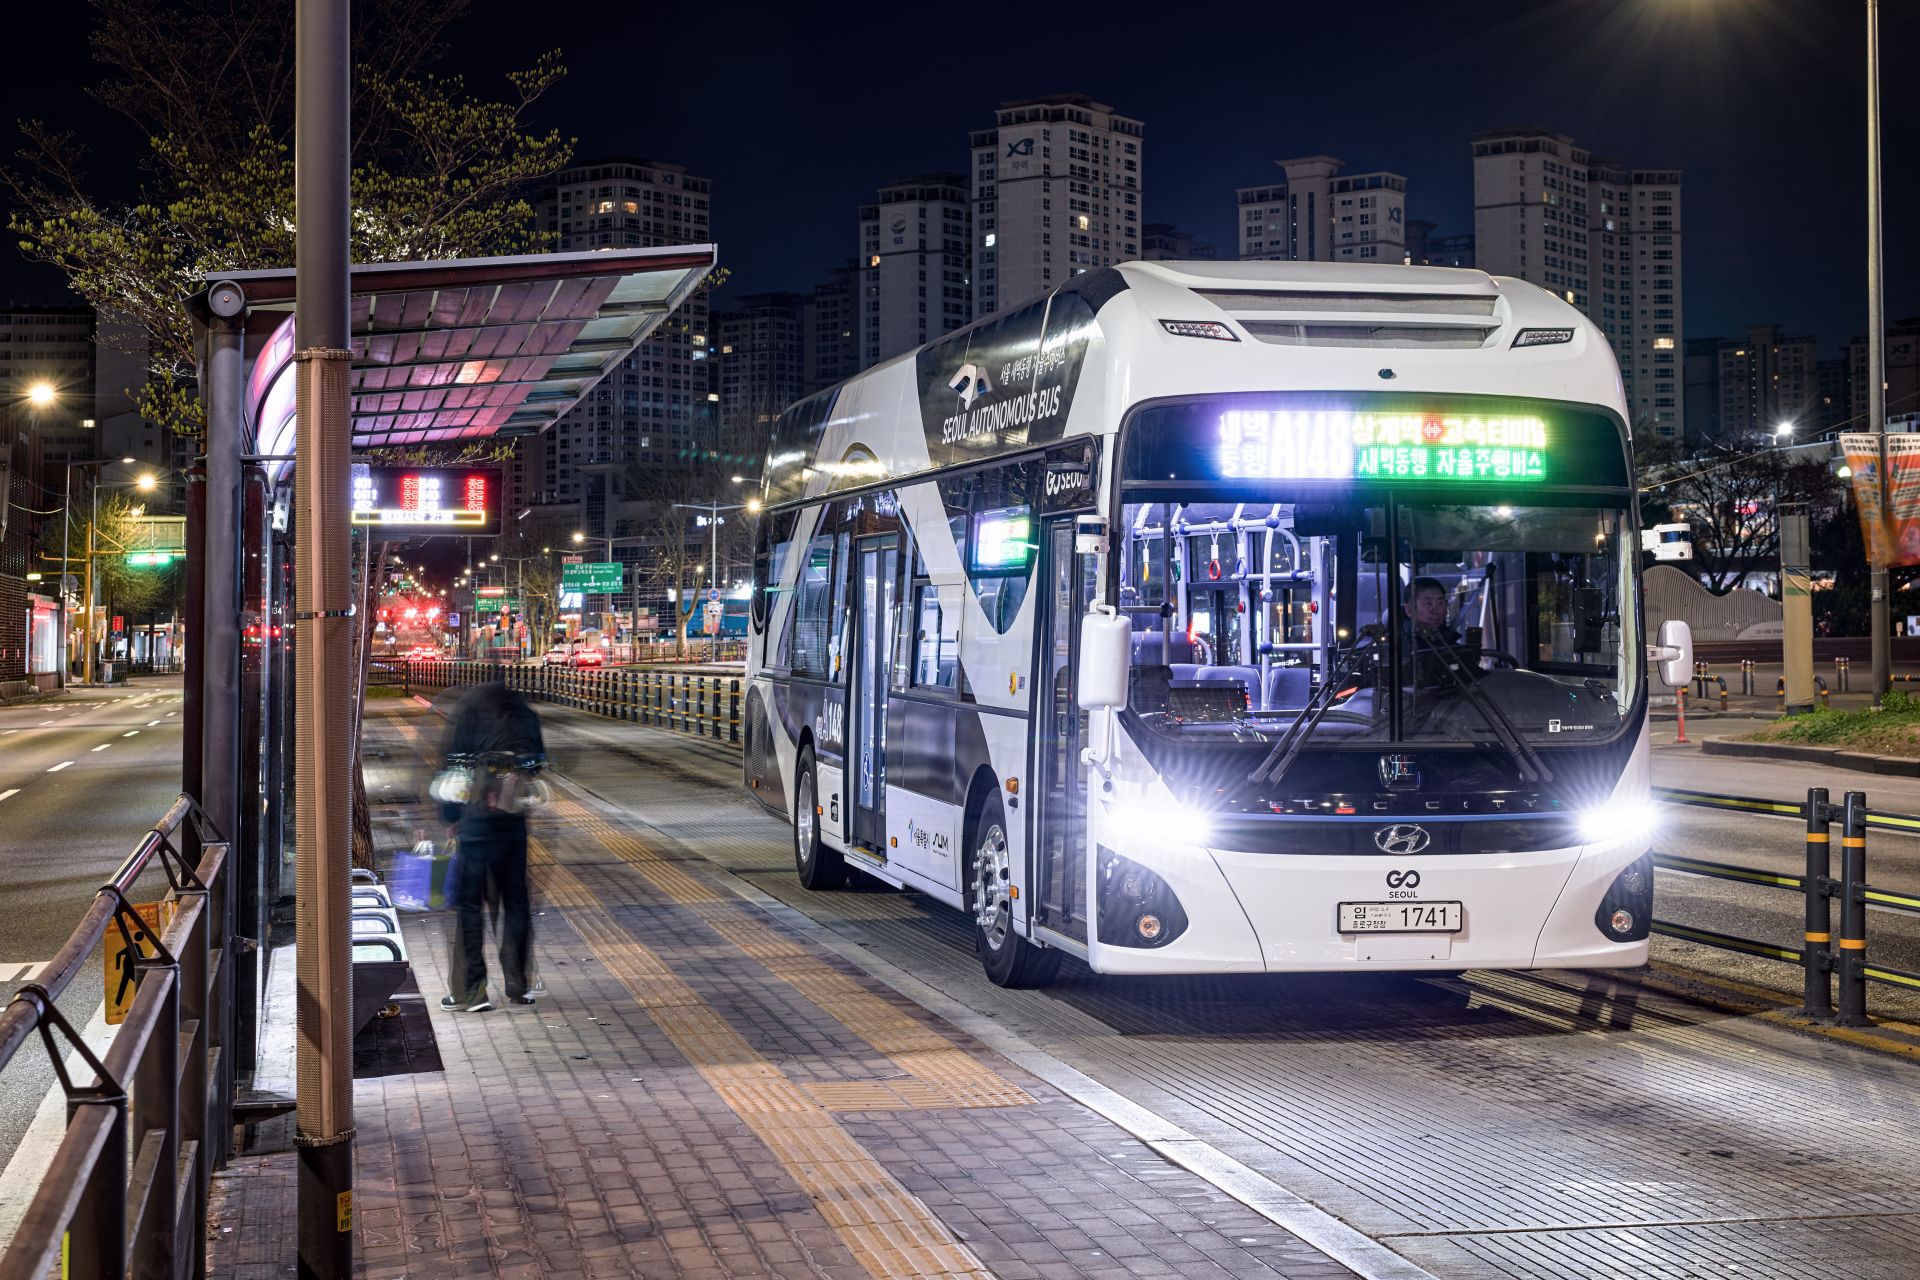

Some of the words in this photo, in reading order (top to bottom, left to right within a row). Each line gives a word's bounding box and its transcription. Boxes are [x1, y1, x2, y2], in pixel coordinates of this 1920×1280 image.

[1000, 363, 1011, 386] 서울
[942, 412, 968, 445] SEOUL
[968, 392, 1037, 438] AUTONOMOUS
[1037, 385, 1061, 420] BUS
[1271, 412, 1348, 476] A148
[1352, 416, 1422, 444] 상계역
[1442, 417, 1546, 447] 고속터미널
[1358, 448, 1428, 475] 새벽동행
[1437, 448, 1542, 476] 자율주행버스
[1061, 472, 1083, 490] SEOU
[822, 698, 842, 744] A148
[1386, 870, 1421, 889] GO
[1388, 891, 1418, 899] SEOUL
[1353, 906, 1366, 919] 임
[1400, 906, 1448, 927] 1741
